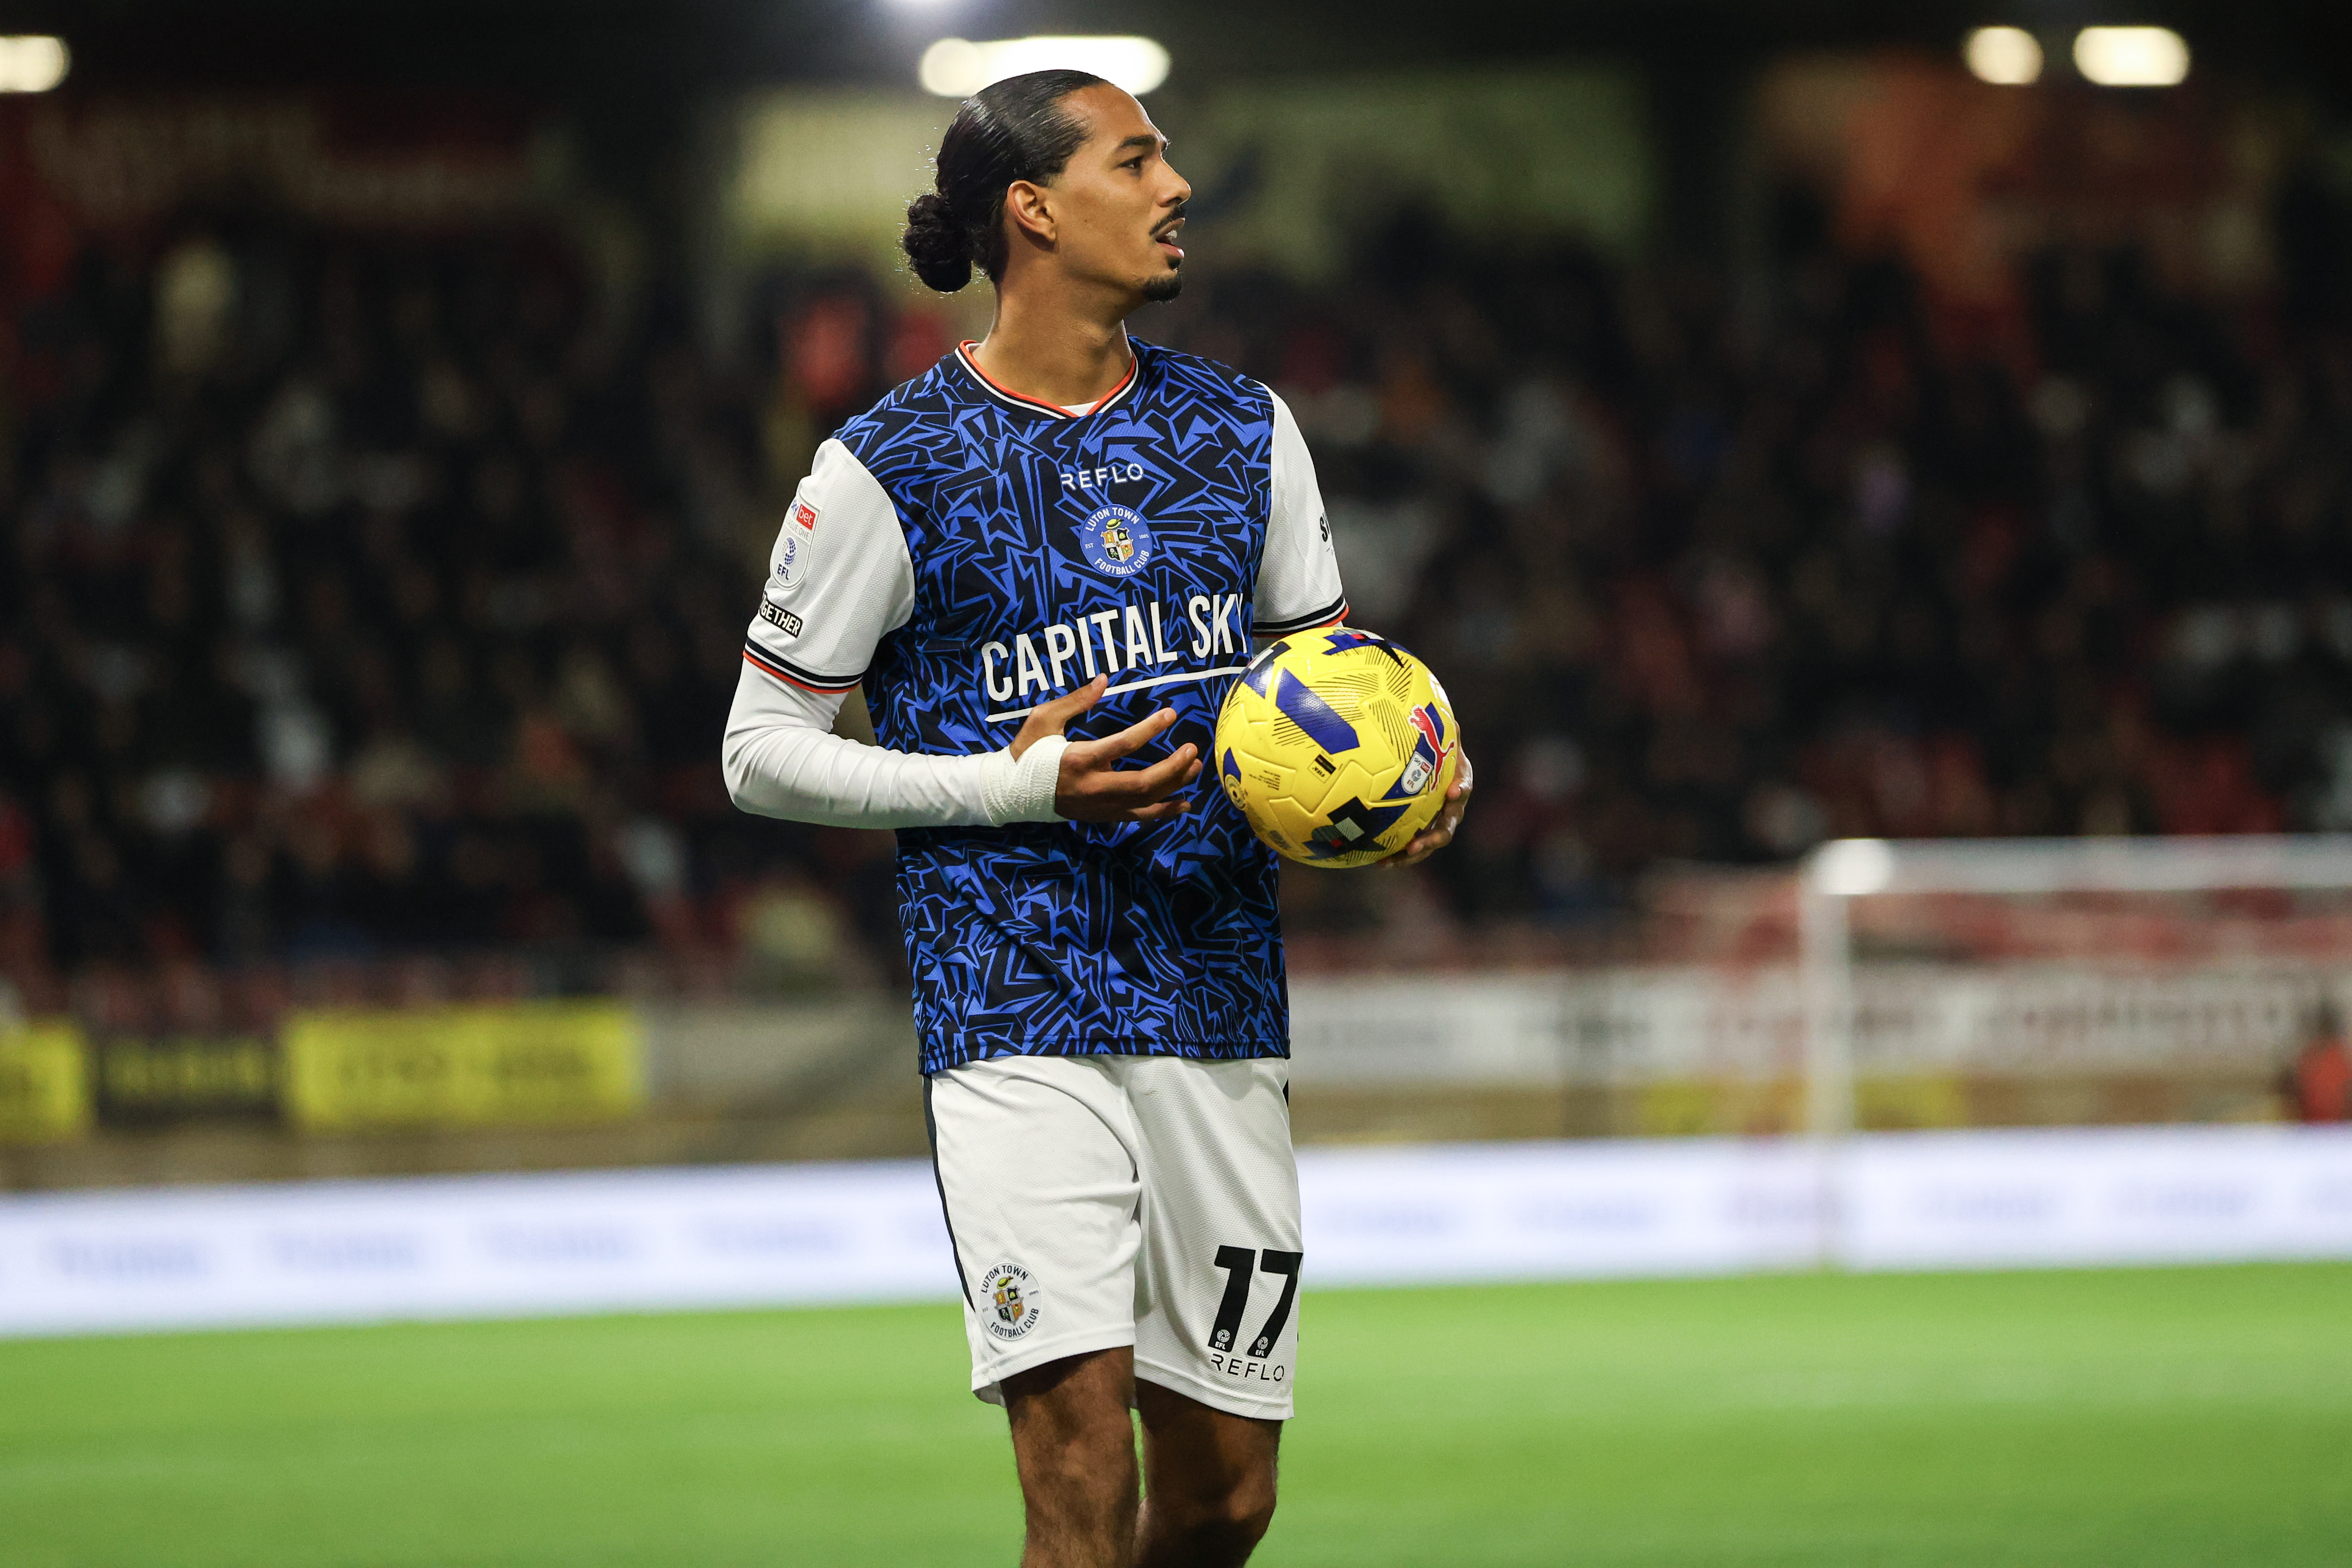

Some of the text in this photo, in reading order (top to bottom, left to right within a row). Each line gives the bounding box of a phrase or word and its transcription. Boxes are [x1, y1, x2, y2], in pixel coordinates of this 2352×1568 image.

[1061, 463, 1143, 491] REFLO
[799, 505, 813, 525] bet
[1085, 507, 1140, 532] LUTON TOWN
[799, 527, 810, 541] ONE
[777, 563, 789, 580] EFL
[1094, 550, 1150, 575] FOOTBALL CLUB
[760, 594, 801, 635] GETHER
[980, 601, 1178, 702] CAPITAL
[981, 1265, 1028, 1293] LUTON TOWN
[1208, 1245, 1304, 1359] 17
[991, 1308, 1039, 1337] FOOTBALL CLUB
[1214, 1341, 1226, 1350] EFL
[1210, 1353, 1285, 1382] REFLO
